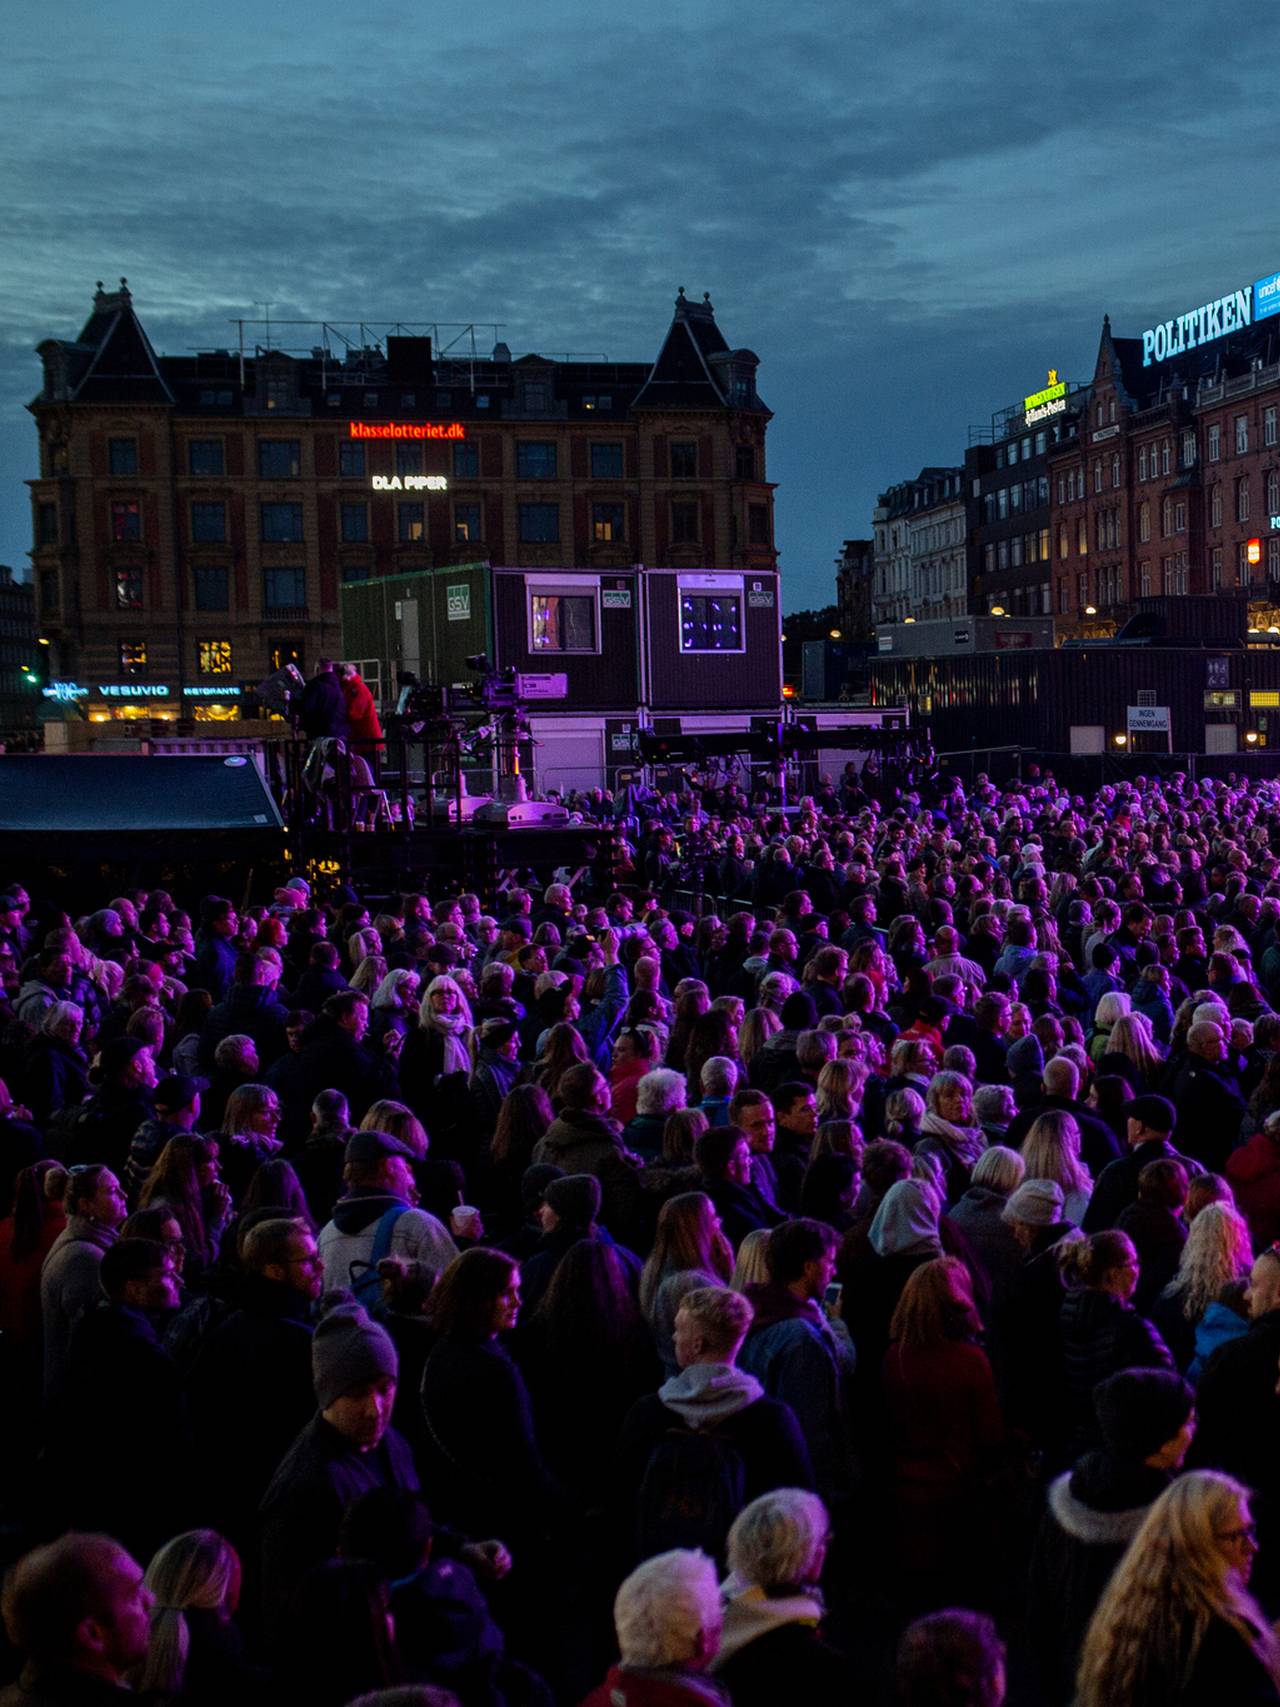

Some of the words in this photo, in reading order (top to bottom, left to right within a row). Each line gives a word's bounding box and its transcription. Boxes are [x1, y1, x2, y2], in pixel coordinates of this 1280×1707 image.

[1258, 277, 1278, 298] unicef
[1142, 286, 1252, 367] POLITIKEN
[350, 421, 465, 439] klasselotteriet.dk
[372, 475, 402, 490] DLA
[404, 475, 447, 490] PIPER
[99, 685, 170, 696] VESUVIO
[183, 687, 241, 696] RISTORANTE
[1138, 709, 1156, 718] INGEN
[1129, 719, 1168, 728] GENNEMGANG
